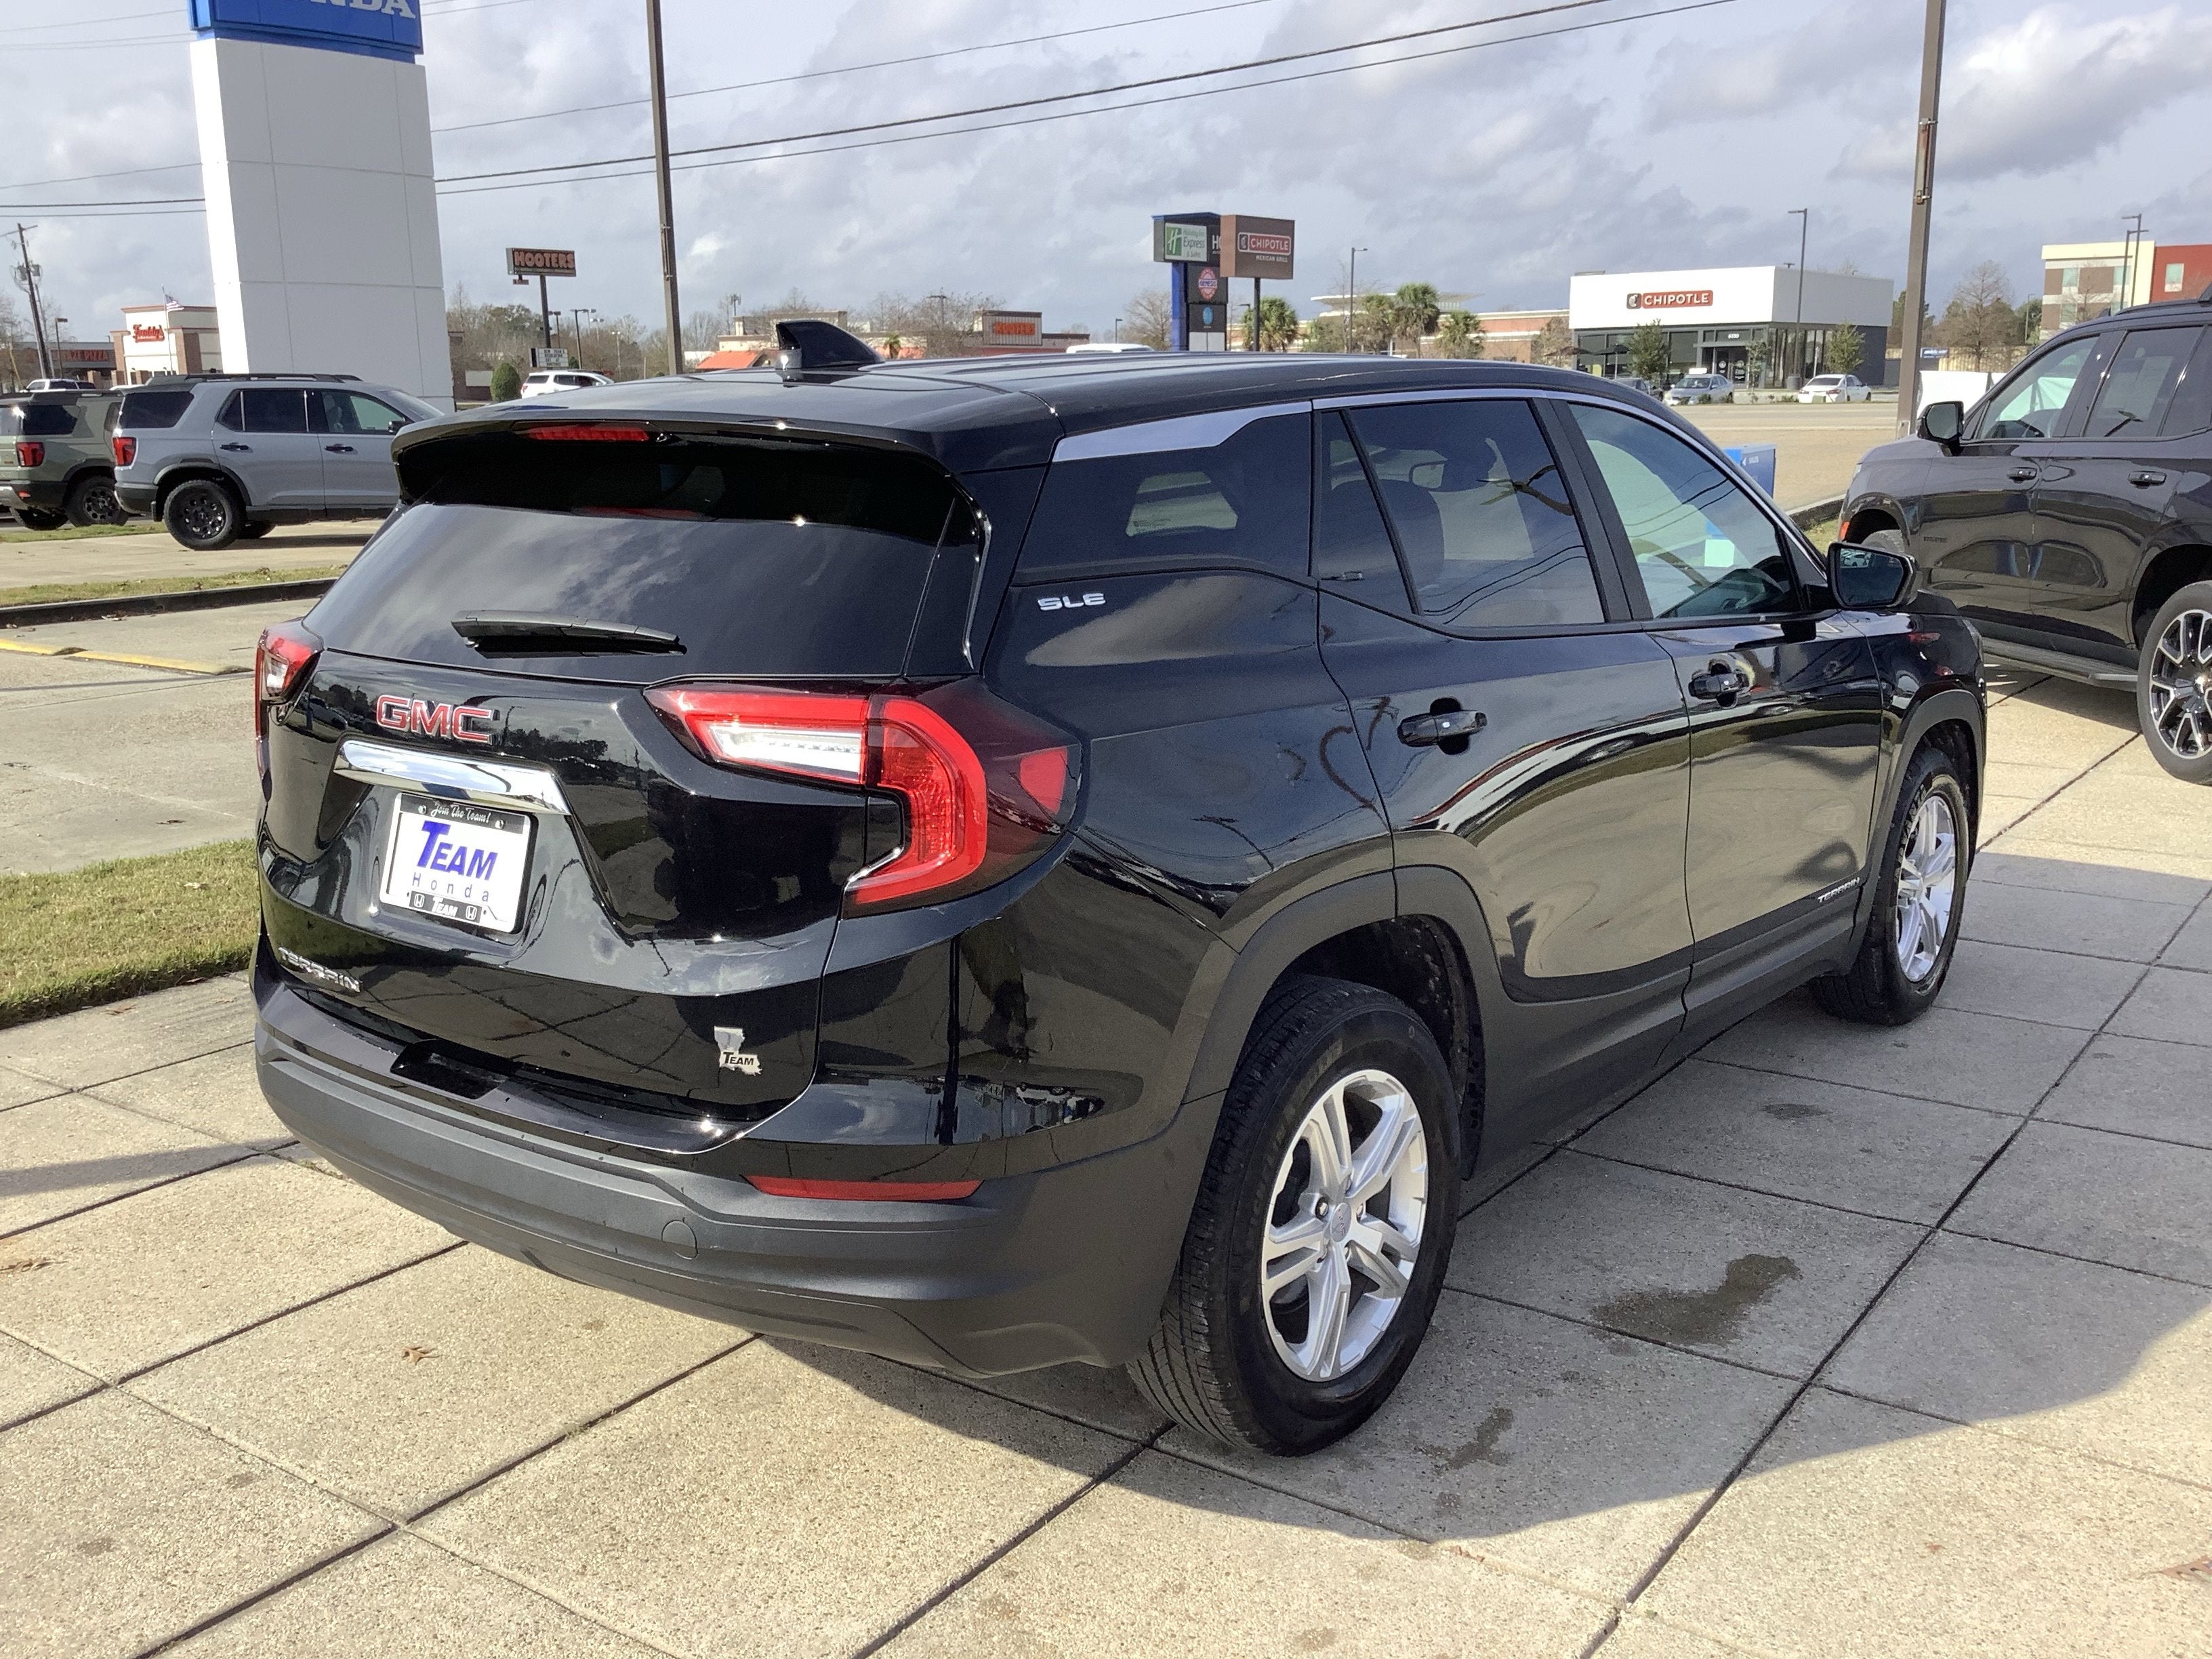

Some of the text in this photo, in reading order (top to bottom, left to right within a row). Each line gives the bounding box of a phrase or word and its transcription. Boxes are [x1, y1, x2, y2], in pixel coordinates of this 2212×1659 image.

[1183, 237, 1205, 249] Express
[1250, 238, 1289, 250] CHIPOTLE
[514, 251, 575, 268] HOOTERS
[1644, 293, 1709, 305] CHIPOTLE
[1038, 592, 1107, 611] SLE
[376, 695, 495, 745] GMC
[430, 802, 491, 823] Join The Team!
